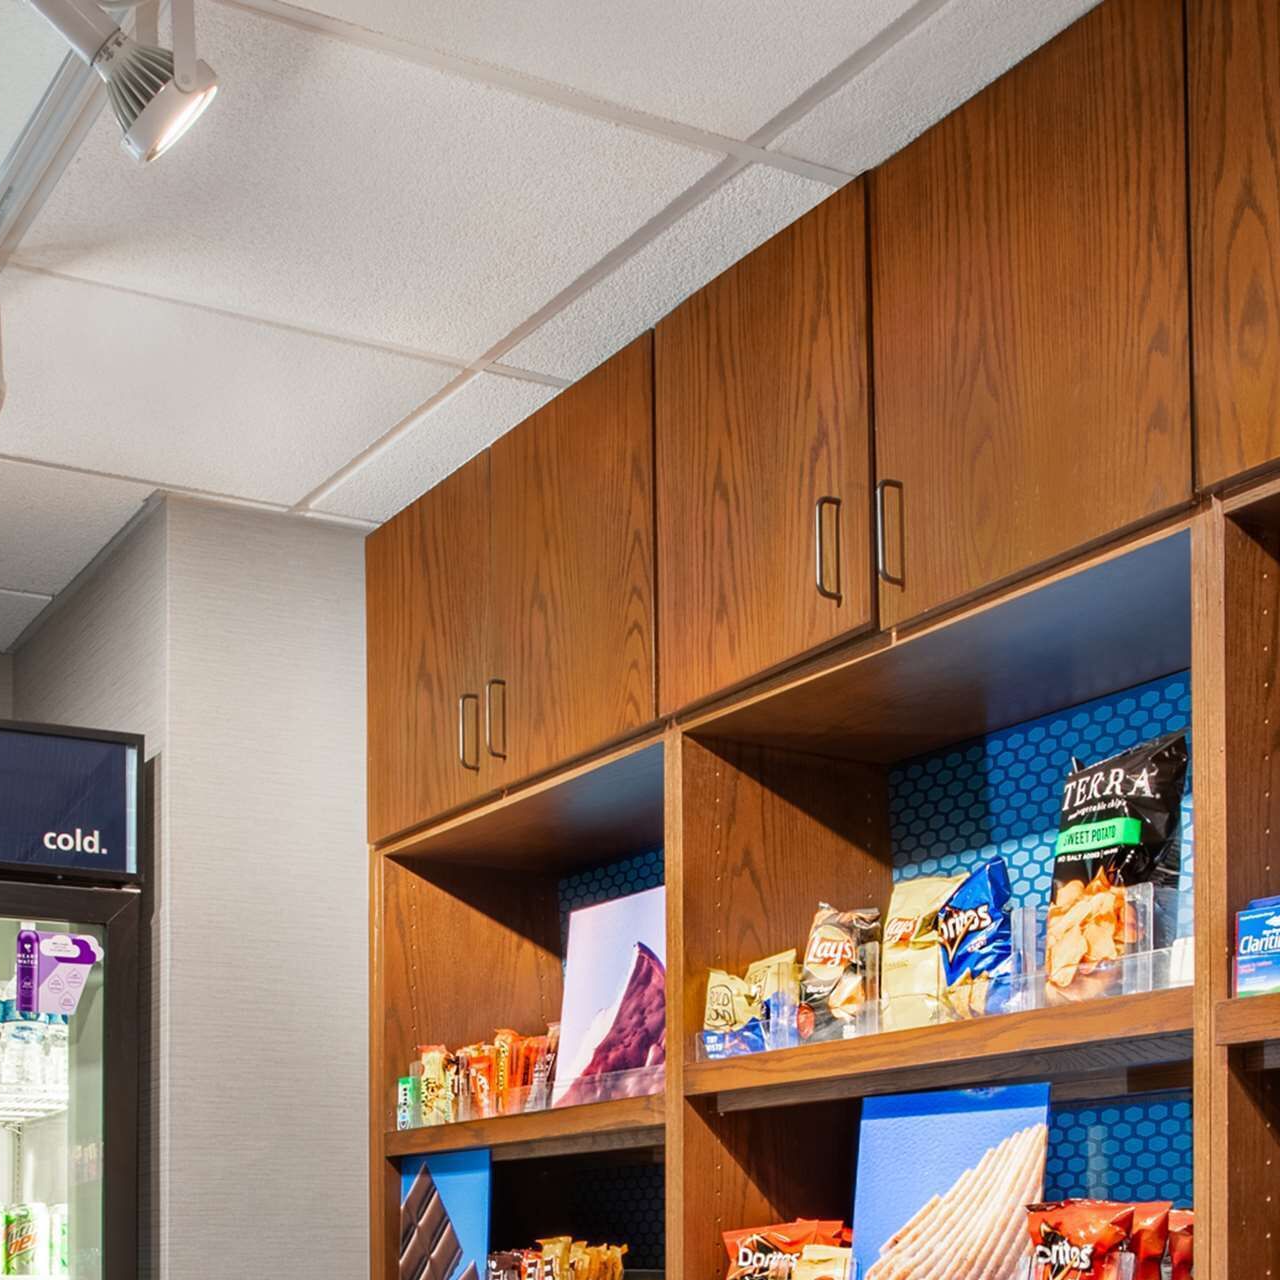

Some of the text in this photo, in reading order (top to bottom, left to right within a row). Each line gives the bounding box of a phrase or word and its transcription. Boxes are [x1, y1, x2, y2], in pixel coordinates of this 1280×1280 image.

[1062, 768, 1157, 812] TERRA
[43, 828, 108, 855] cold.
[1091, 825, 1117, 844] POTATO
[807, 935, 853, 967] Lay's
[738, 1248, 800, 1268] Doritos
[1036, 1239, 1094, 1269] Doritos
